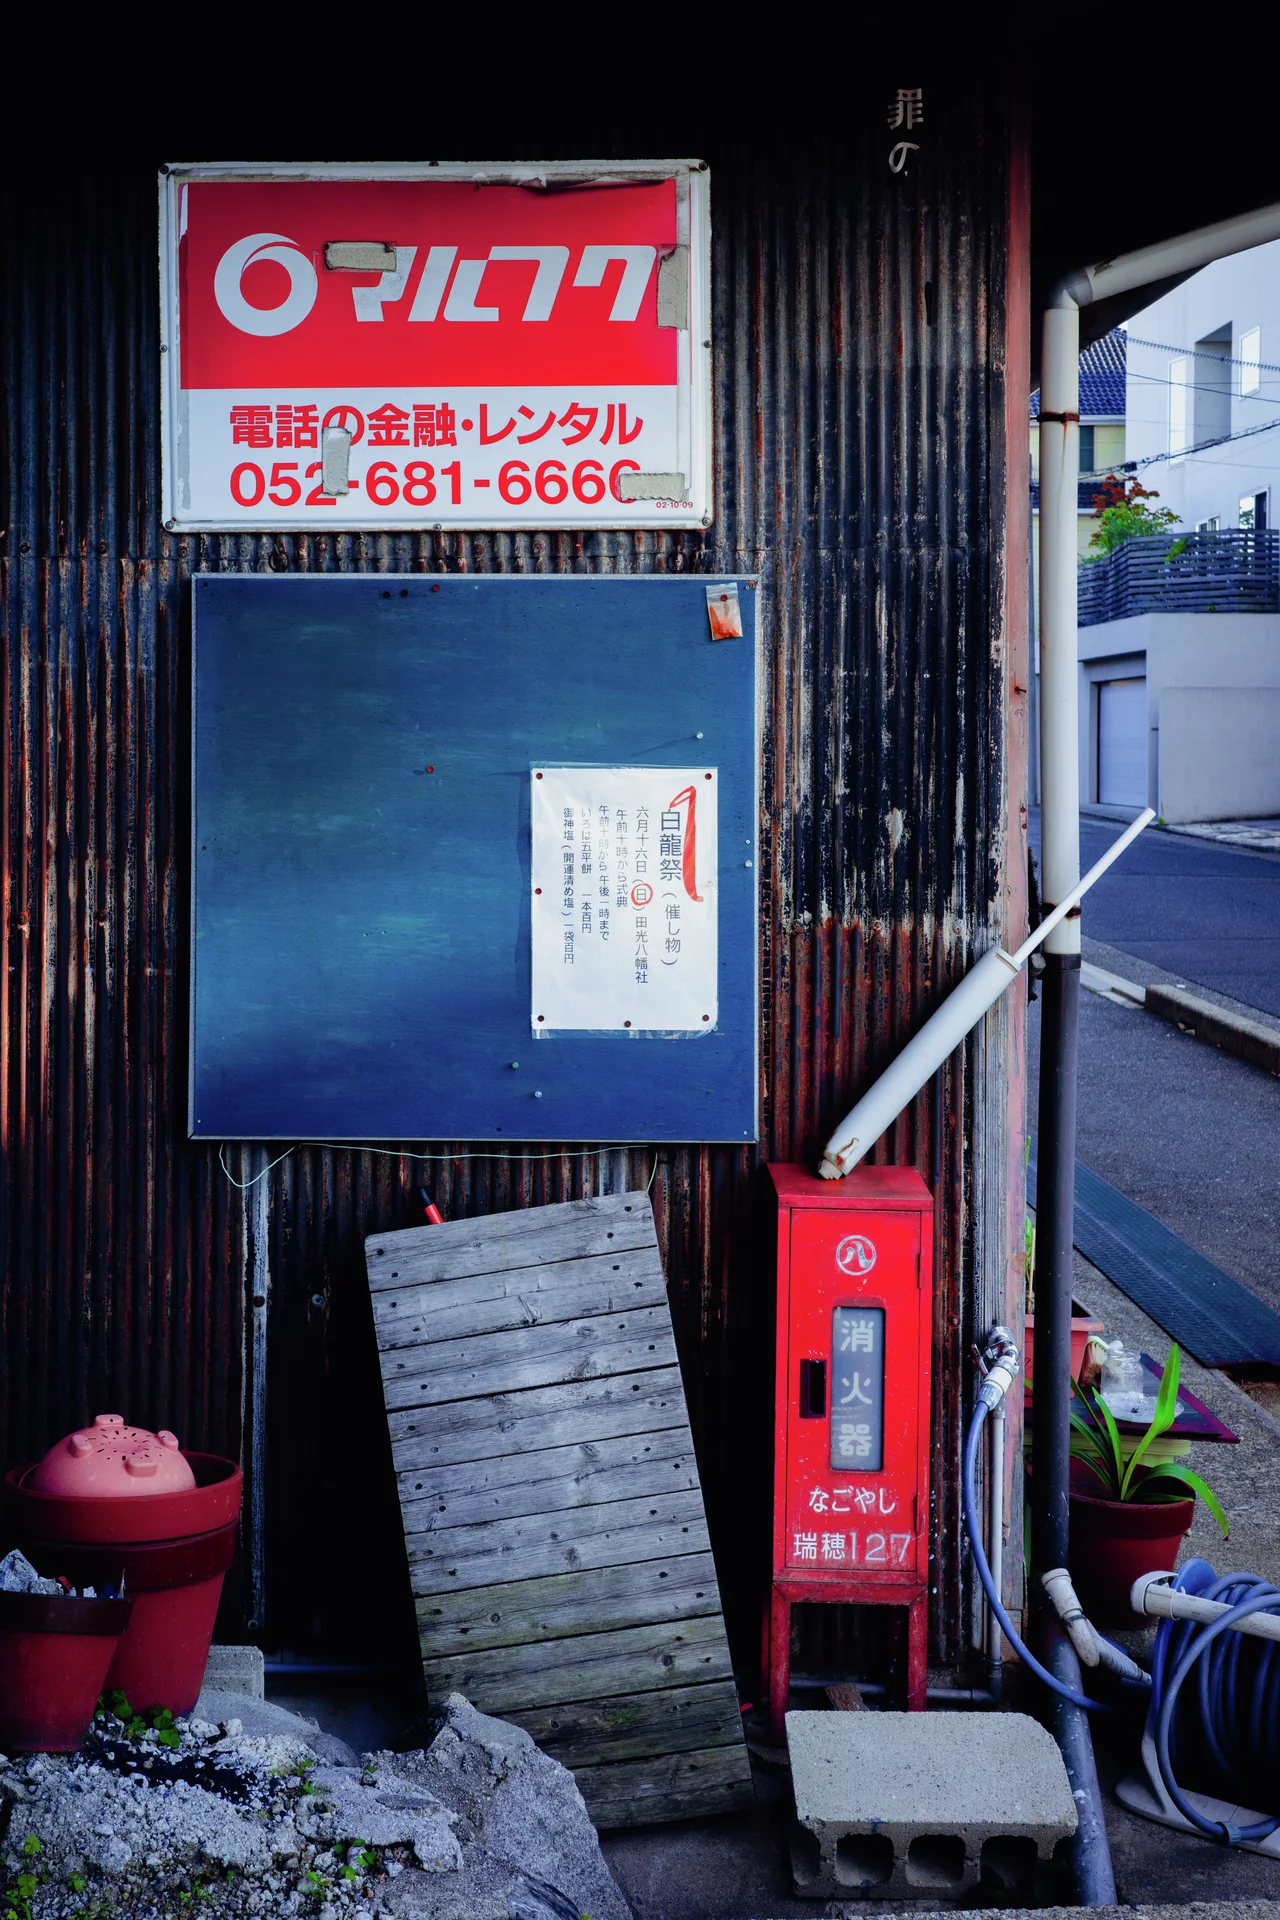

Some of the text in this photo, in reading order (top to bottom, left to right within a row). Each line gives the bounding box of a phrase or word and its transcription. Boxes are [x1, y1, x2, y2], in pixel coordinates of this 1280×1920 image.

[615, 809, 629, 908] 午前十時から式典
[581, 892, 593, 934] 一本百円
[839, 1319, 873, 1457] 消火器
[808, 1485, 897, 1514] なごやし
